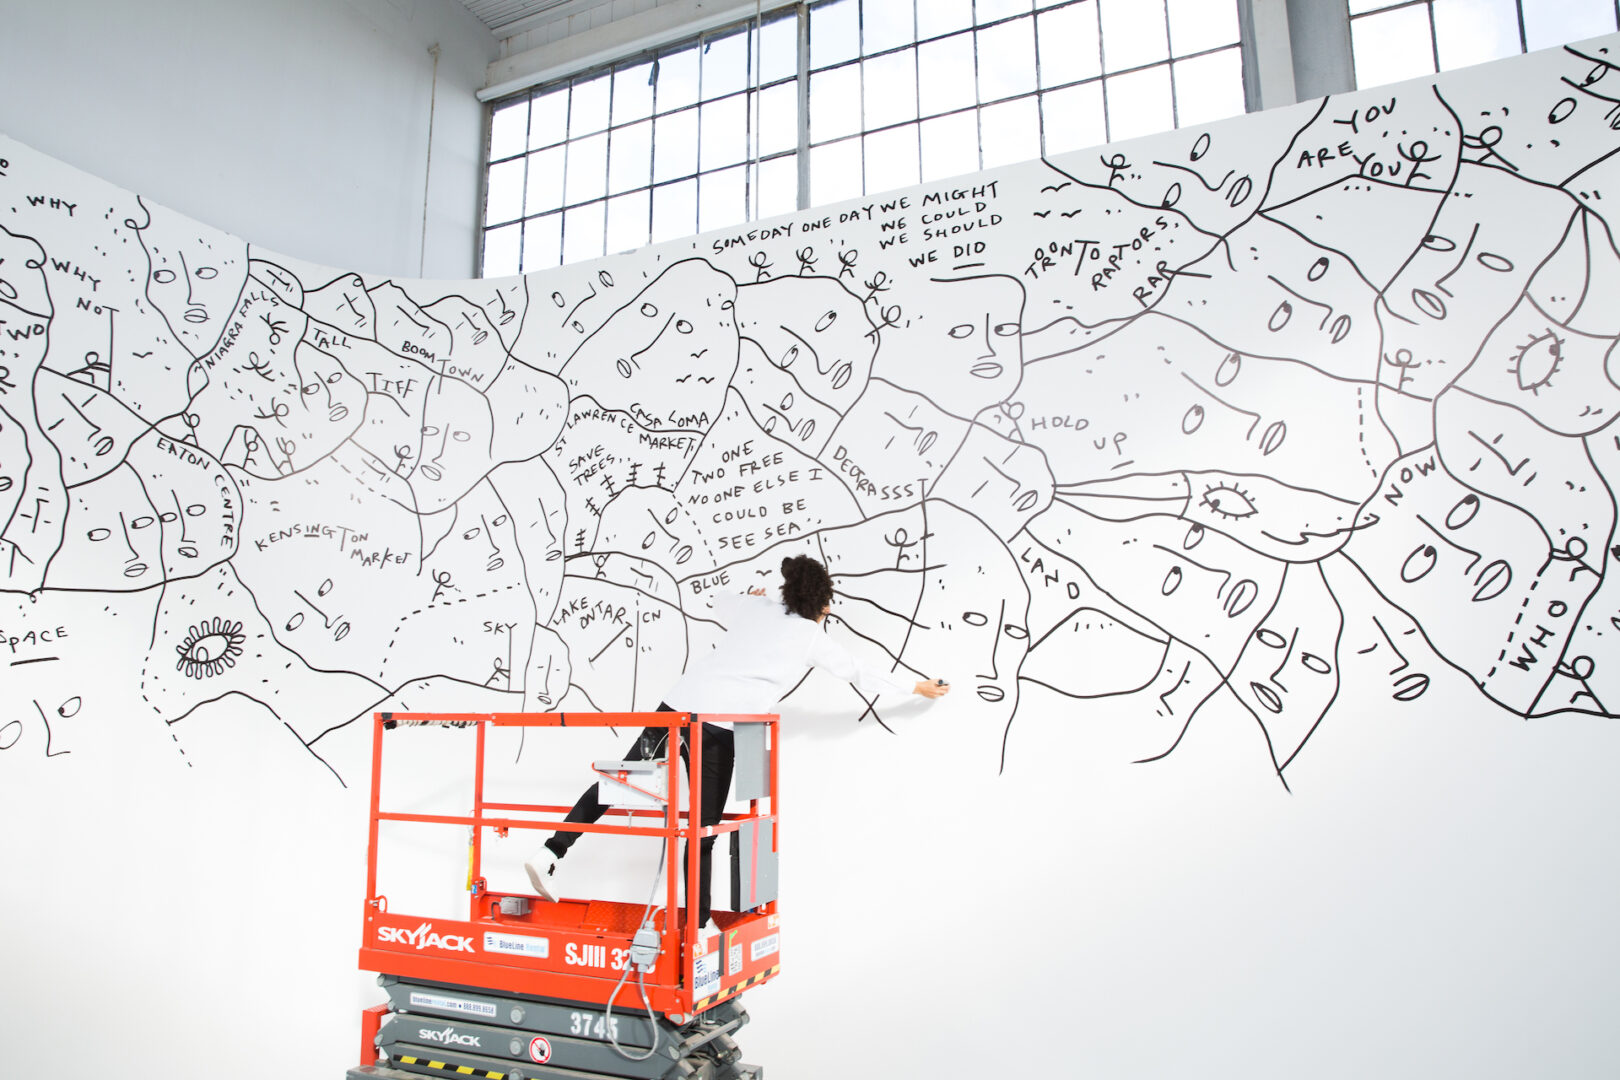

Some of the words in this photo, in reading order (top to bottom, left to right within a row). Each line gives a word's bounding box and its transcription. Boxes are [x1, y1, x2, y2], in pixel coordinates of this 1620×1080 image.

[1334, 97, 1396, 134] YOU
[1297, 141, 1352, 168] ARE
[1353, 153, 1401, 176] YOU
[27, 195, 77, 217] WHY
[712, 222, 794, 255] SOMEDAY
[802, 217, 831, 233] ONE
[839, 204, 875, 224] DAY
[880, 197, 911, 213] WE
[922, 180, 999, 207] MIGHT
[881, 217, 907, 232] WE
[921, 201, 987, 225] COULD
[879, 233, 909, 250] WE
[923, 214, 1003, 242] SHOULD
[908, 249, 938, 268] WE
[953, 241, 986, 258] DID
[1092, 216, 1168, 291] RAPTORS
[51, 257, 101, 292] WHY
[205, 321, 244, 370] NIAGRA
[239, 292, 280, 317] FALLS
[312, 328, 352, 349] TALL
[366, 372, 418, 398] TIFF
[630, 403, 662, 428] CASA
[668, 410, 709, 428] LOMA
[1031, 416, 1089, 430] HOLD
[555, 436, 567, 456] ST
[567, 409, 634, 434] LAWRENCE
[639, 433, 696, 459] MARKET
[1093, 432, 1127, 455] UP
[568, 444, 605, 474] SAVE
[722, 440, 754, 462] ONE
[573, 454, 615, 486] TREES
[692, 468, 725, 484] TWO
[739, 452, 783, 477] FREE
[1384, 456, 1436, 507] NOW
[156, 437, 210, 470] EATON
[214, 474, 235, 549] CENTRE
[688, 495, 709, 505] NO
[714, 486, 745, 503] ONE
[753, 471, 799, 494] ELSE
[808, 468, 823, 480] I
[713, 506, 767, 524] COULD
[782, 499, 806, 514] BE
[255, 523, 368, 551] KENSINGTON
[718, 533, 755, 549] SEE
[764, 522, 800, 540] SEA
[350, 547, 412, 569] MARKET
[690, 571, 730, 595] BLUE
[1021, 547, 1080, 600] LAND
[553, 596, 589, 626] LAKE
[642, 610, 662, 623] CN
[0, 626, 68, 653] SPACE
[1509, 600, 1568, 671] WHO
[377, 922, 476, 953] SKYJACK
[565, 942, 606, 968] SJIII
[611, 948, 656, 974] 32
[418, 1027, 482, 1047] SKYJACK
